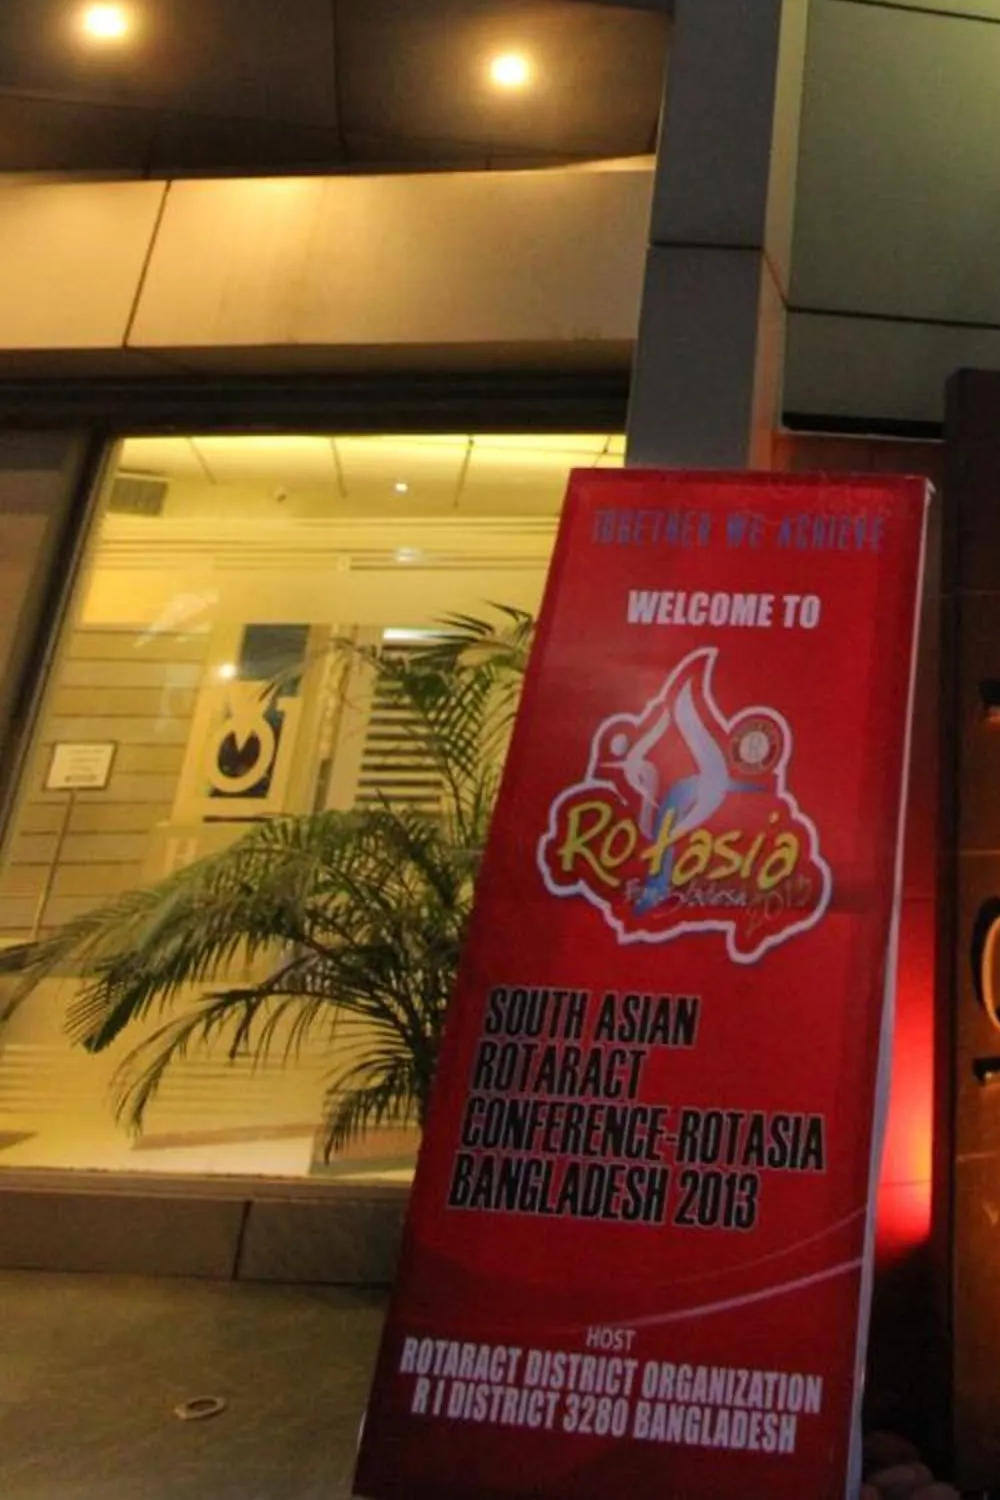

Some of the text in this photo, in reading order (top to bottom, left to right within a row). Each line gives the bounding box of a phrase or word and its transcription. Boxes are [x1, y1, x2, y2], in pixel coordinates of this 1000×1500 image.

[724, 512, 763, 549] WE
[777, 512, 884, 552] ACHIEVE
[626, 588, 822, 629] WELCOME TO
[557, 801, 798, 888] Rotasia
[484, 987, 700, 1047] SOUTH ASIAN
[471, 1040, 648, 1100] ROTARACT
[460, 1097, 825, 1171] CONFERENCE-ROTASIA
[448, 1152, 760, 1229] BANGLADESH 2013
[585, 1326, 636, 1352] HOST
[400, 1336, 824, 1414] ROTARACT DISTRICT ORGANIZATION
[411, 1377, 429, 1415] R
[448, 1384, 562, 1430] DISTRICT
[562, 1395, 625, 1439] 3280
[632, 1401, 799, 1455] BANGLADESH
